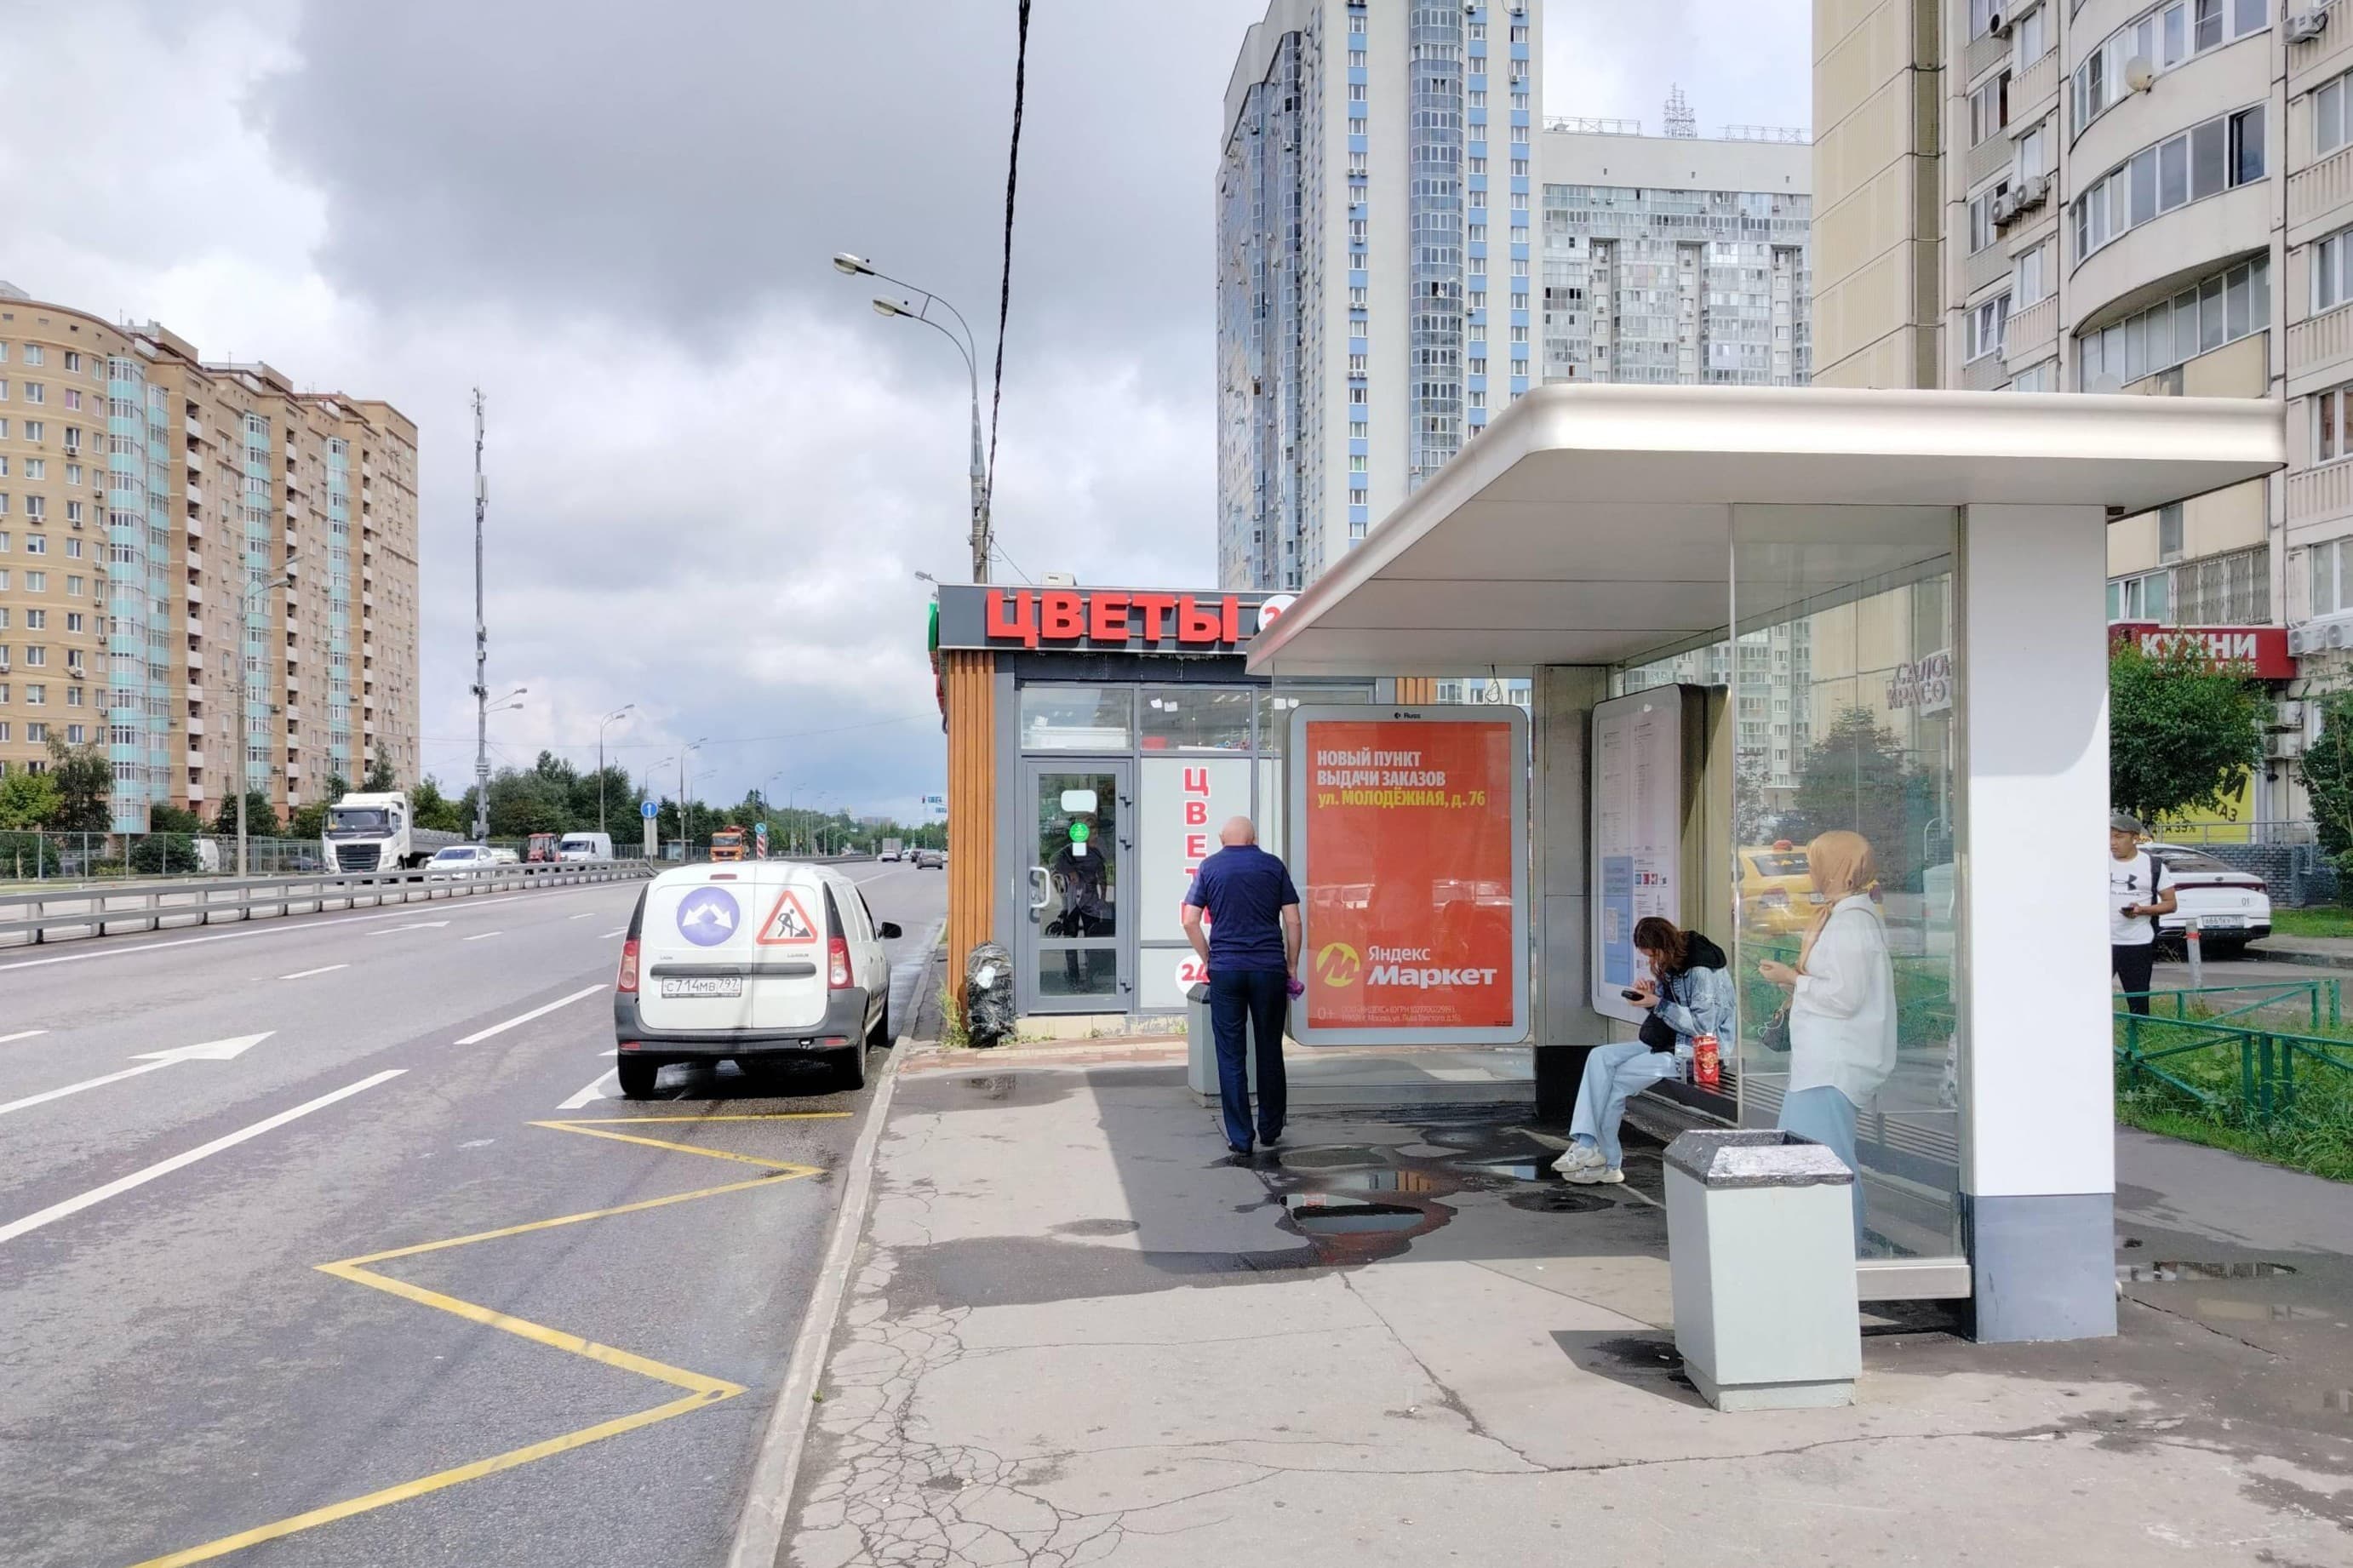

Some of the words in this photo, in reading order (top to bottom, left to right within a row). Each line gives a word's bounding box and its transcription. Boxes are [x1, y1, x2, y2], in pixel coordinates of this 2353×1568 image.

[987, 590, 1239, 649] ЦВЕТЫ
[2141, 633, 2256, 659] КУХНИ
[1317, 747, 1371, 766] НОВЫЙ
[1374, 751, 1422, 767] ПУНКТ
[1317, 770, 1379, 789] ВЫДАЧИ
[1382, 770, 1446, 787] ЗАКАЗОВ
[1318, 793, 1338, 808] ул.
[1342, 787, 1449, 808] МОЛОДЁЖНАЯ,
[1451, 795, 1466, 808] д.
[1468, 791, 1486, 805] 76
[1368, 945, 1431, 964] Яндекс
[1367, 965, 1497, 989] Маркет
